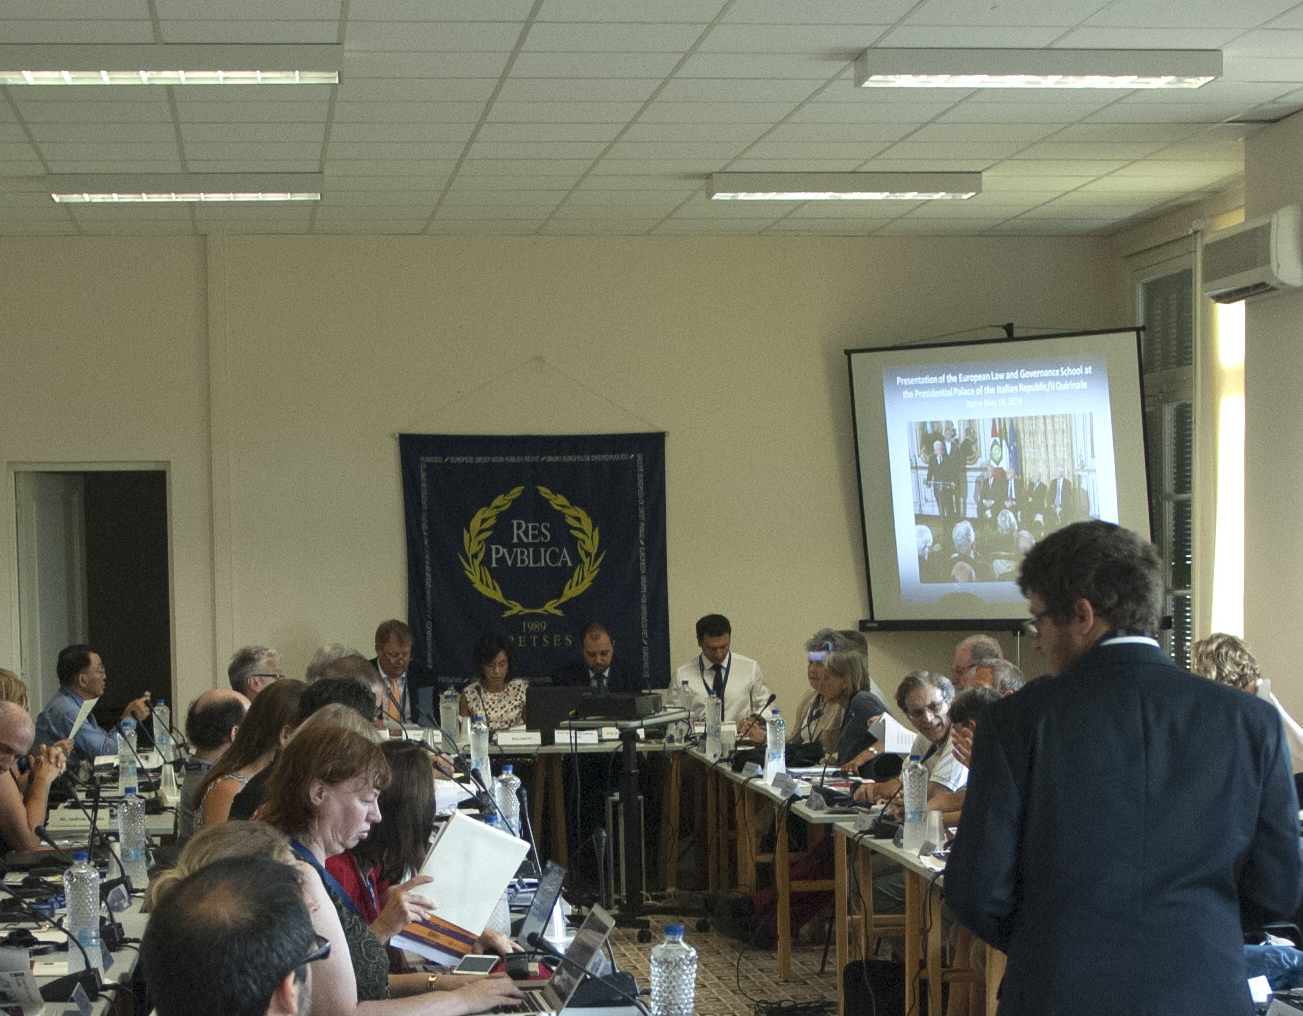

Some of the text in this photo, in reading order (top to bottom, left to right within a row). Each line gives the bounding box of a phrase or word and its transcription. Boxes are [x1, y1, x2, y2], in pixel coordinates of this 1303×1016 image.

[896, 365, 1092, 385] Presentation of the European Law and Governance School at
[903, 389, 913, 399] the
[915, 387, 952, 398] Presidential
[954, 386, 974, 396] Palace
[976, 385, 983, 395] of
[984, 384, 995, 394] the
[996, 383, 1018, 394] Italian
[522, 621, 547, 633] 1989
